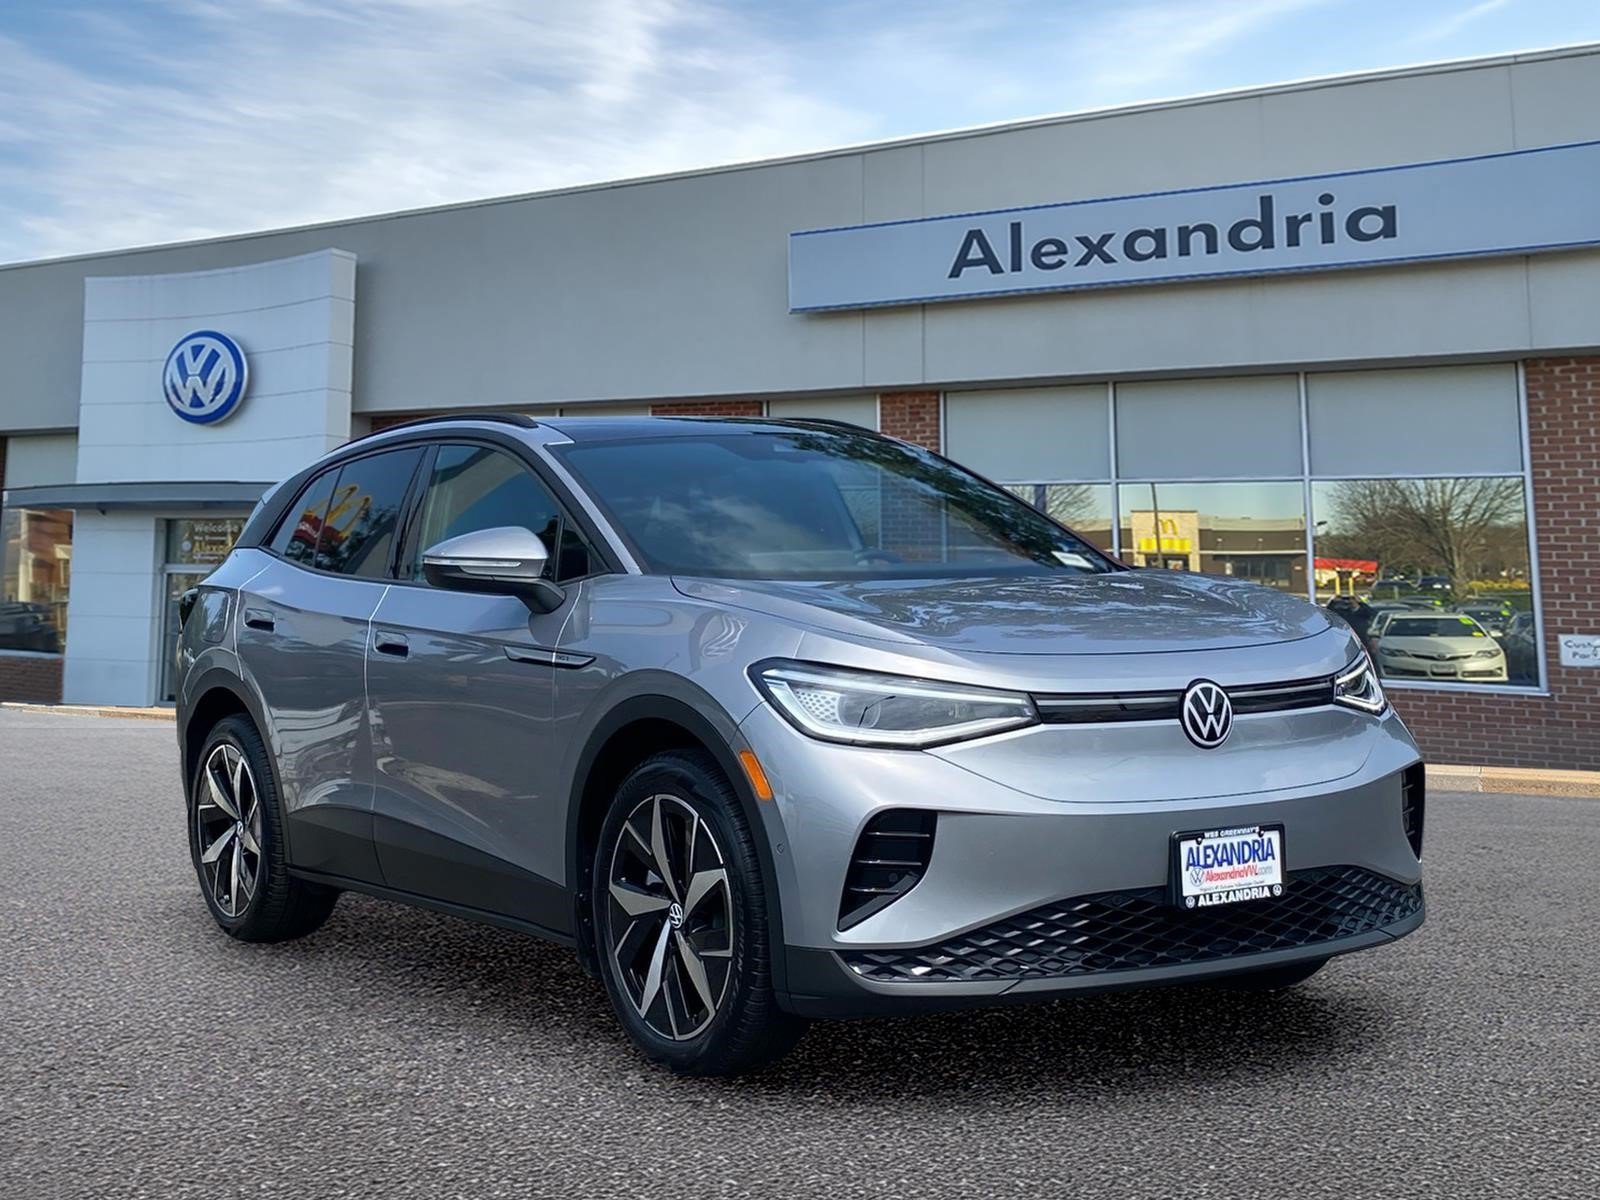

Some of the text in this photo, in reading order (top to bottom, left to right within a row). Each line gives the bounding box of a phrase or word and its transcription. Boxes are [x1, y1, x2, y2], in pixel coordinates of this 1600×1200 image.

[948, 193, 1398, 279] Alexandria
[1186, 837, 1275, 871] ALEXANDRIA
[1198, 886, 1270, 907] ALEXANDRIA
